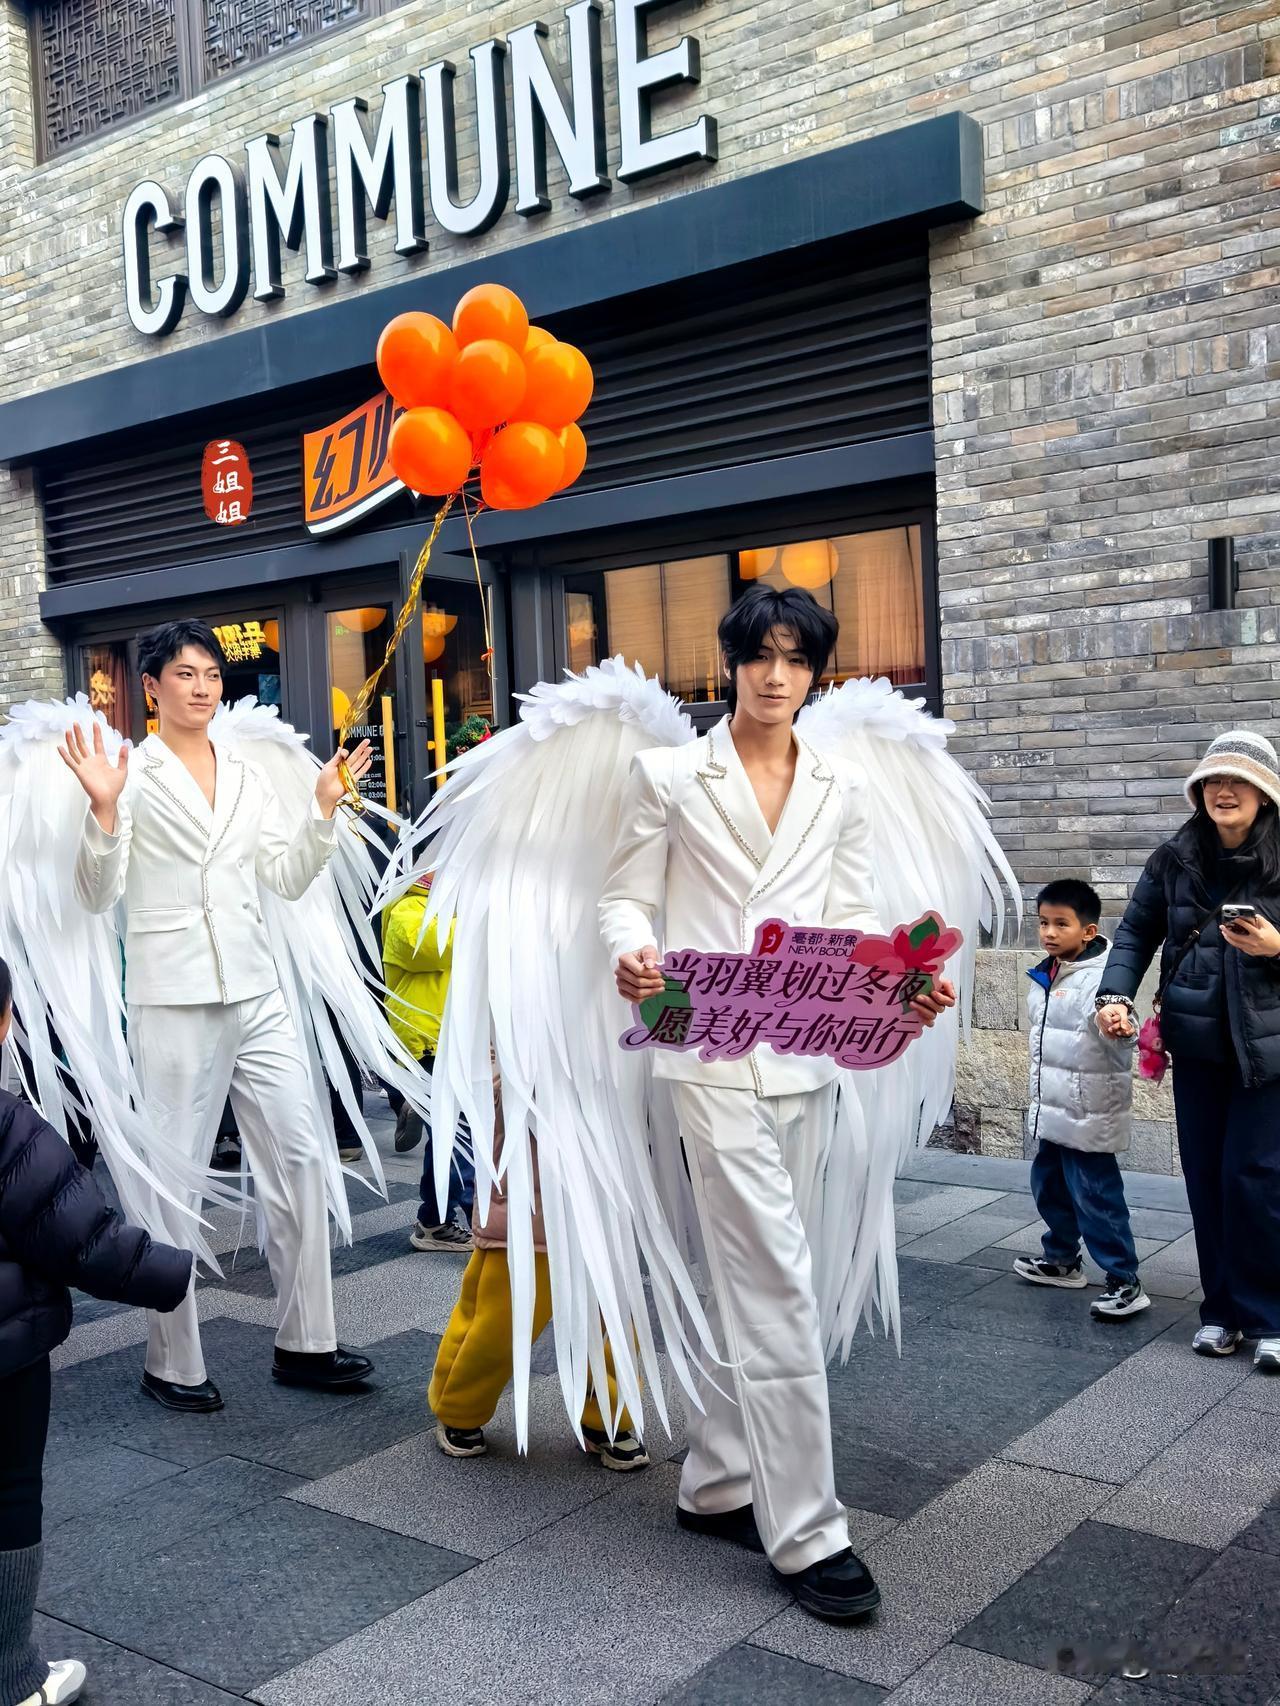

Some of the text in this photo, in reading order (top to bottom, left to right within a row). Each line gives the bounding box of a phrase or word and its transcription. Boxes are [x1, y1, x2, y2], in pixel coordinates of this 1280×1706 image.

[122, 0, 717, 337] COMMUNE
[210, 439, 247, 525] 三姐姐
[664, 953, 933, 1008] 当羽翼划过冬夜
[788, 945, 855, 957] NEW BODU
[625, 1004, 920, 1065] 愿美好与你同行
